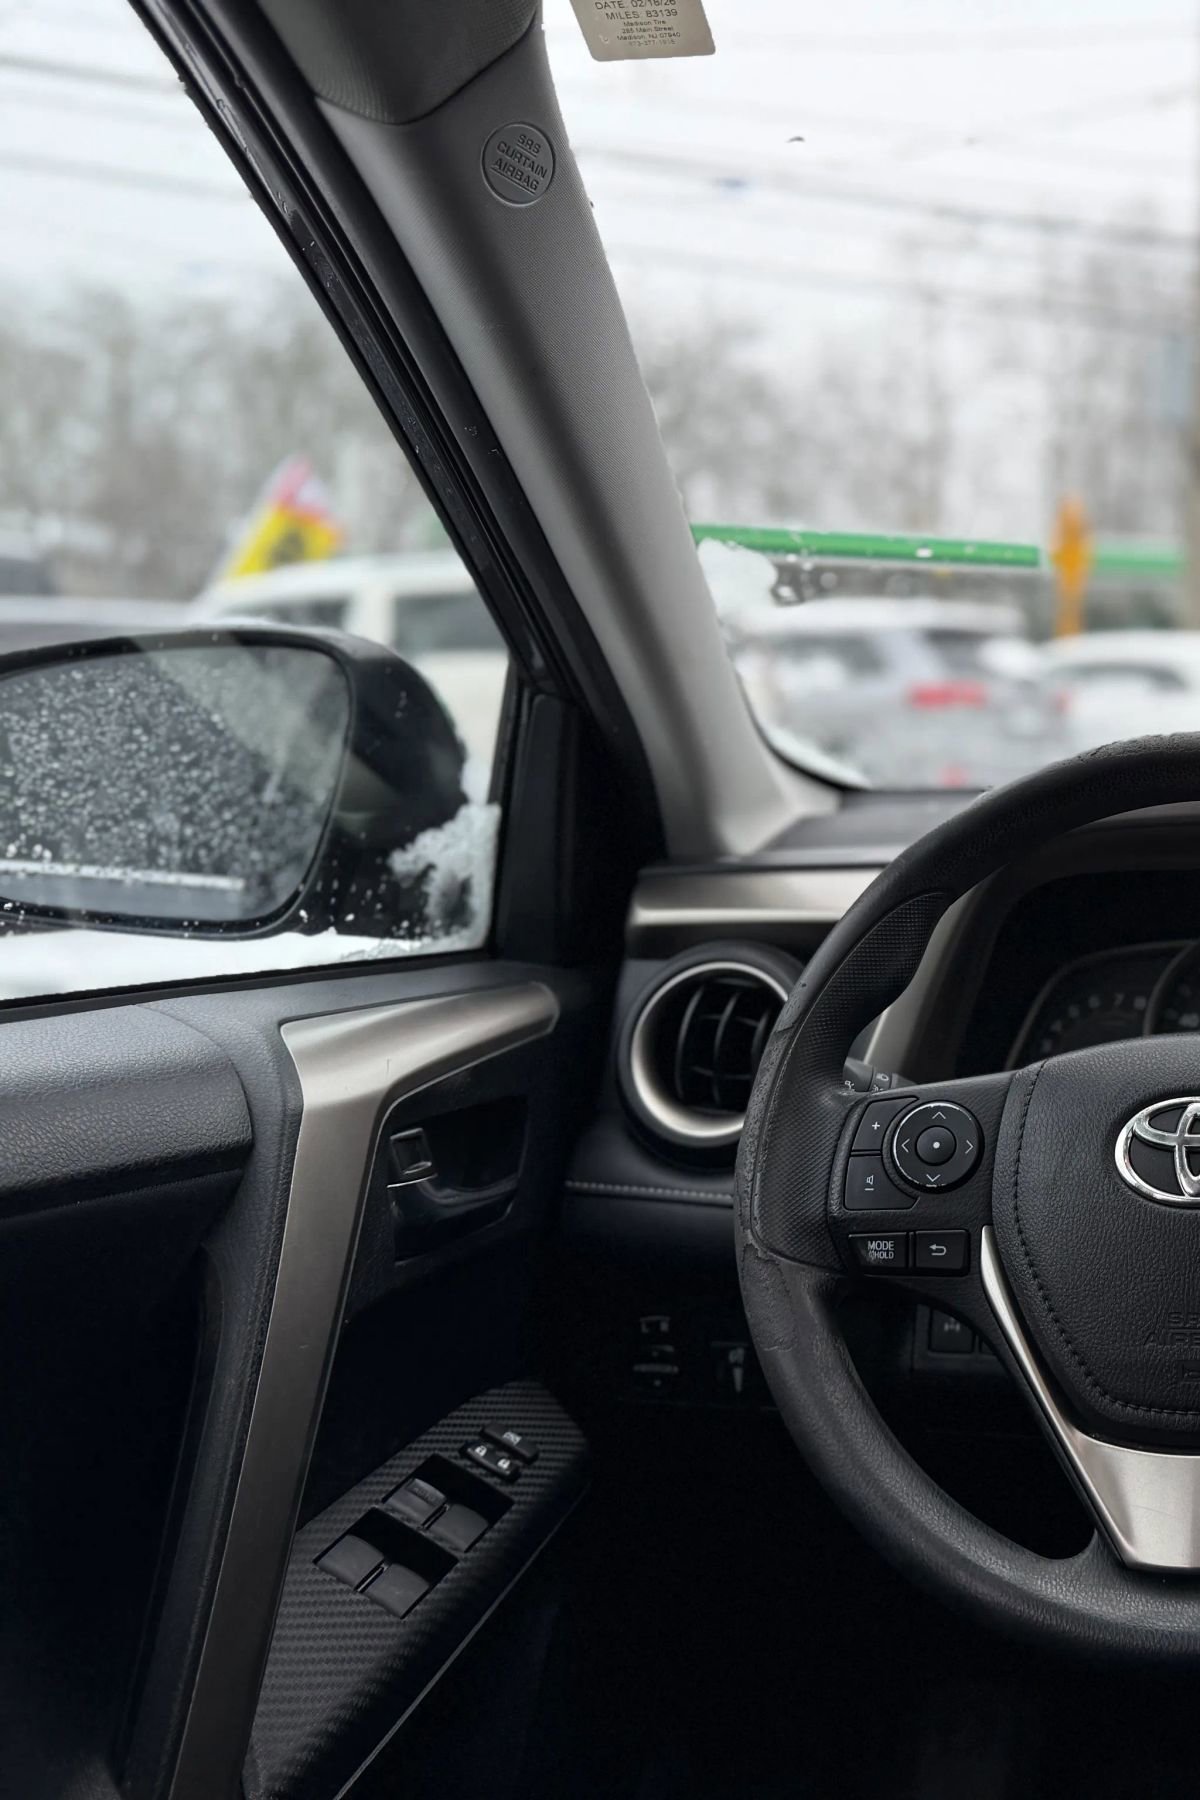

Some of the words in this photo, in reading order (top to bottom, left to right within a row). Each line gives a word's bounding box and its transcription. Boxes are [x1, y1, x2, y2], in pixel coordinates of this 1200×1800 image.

[645, 8, 678, 18] 83139
[517, 134, 541, 154] SRS
[496, 140, 548, 179] CURTAIN
[493, 158, 539, 191] AIRBAG
[867, 1240, 895, 1251] MODE
[874, 1251, 895, 1259] HOLD
